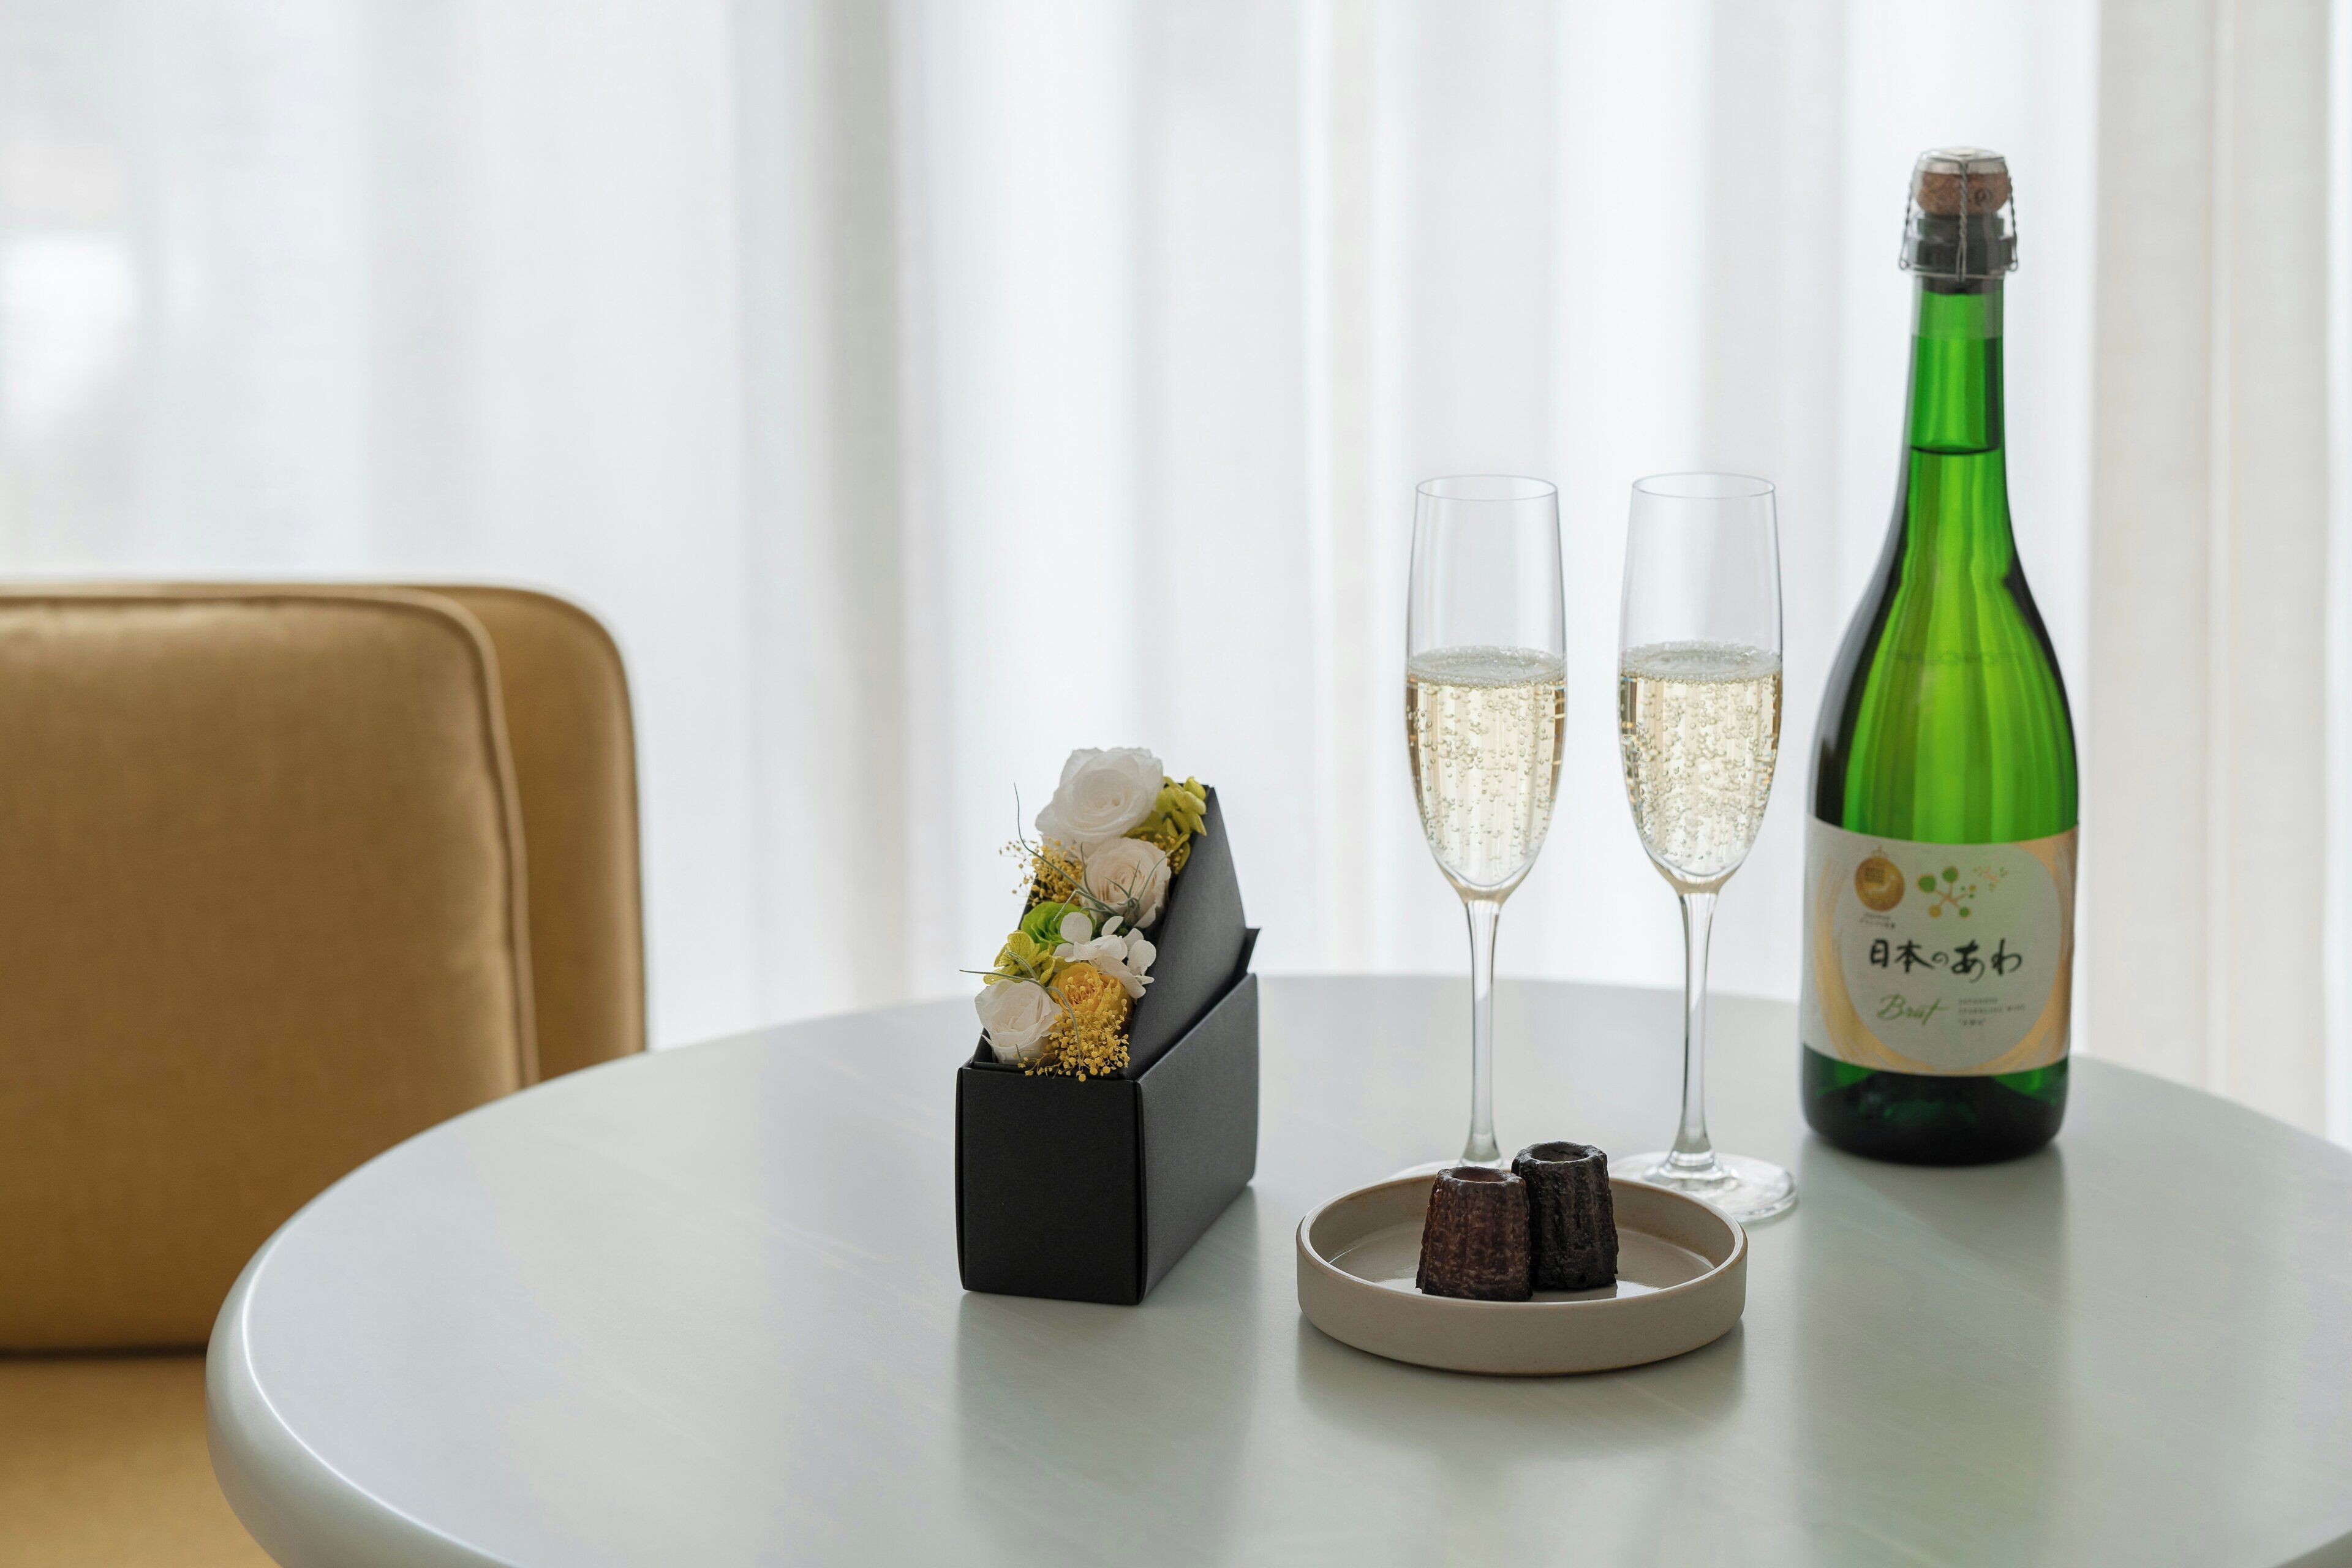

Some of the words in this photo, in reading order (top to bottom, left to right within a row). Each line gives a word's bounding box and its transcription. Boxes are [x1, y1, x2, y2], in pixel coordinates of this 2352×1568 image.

[1870, 937, 2023, 983] 日本のあわ
[1877, 993, 1950, 1026] Brut
